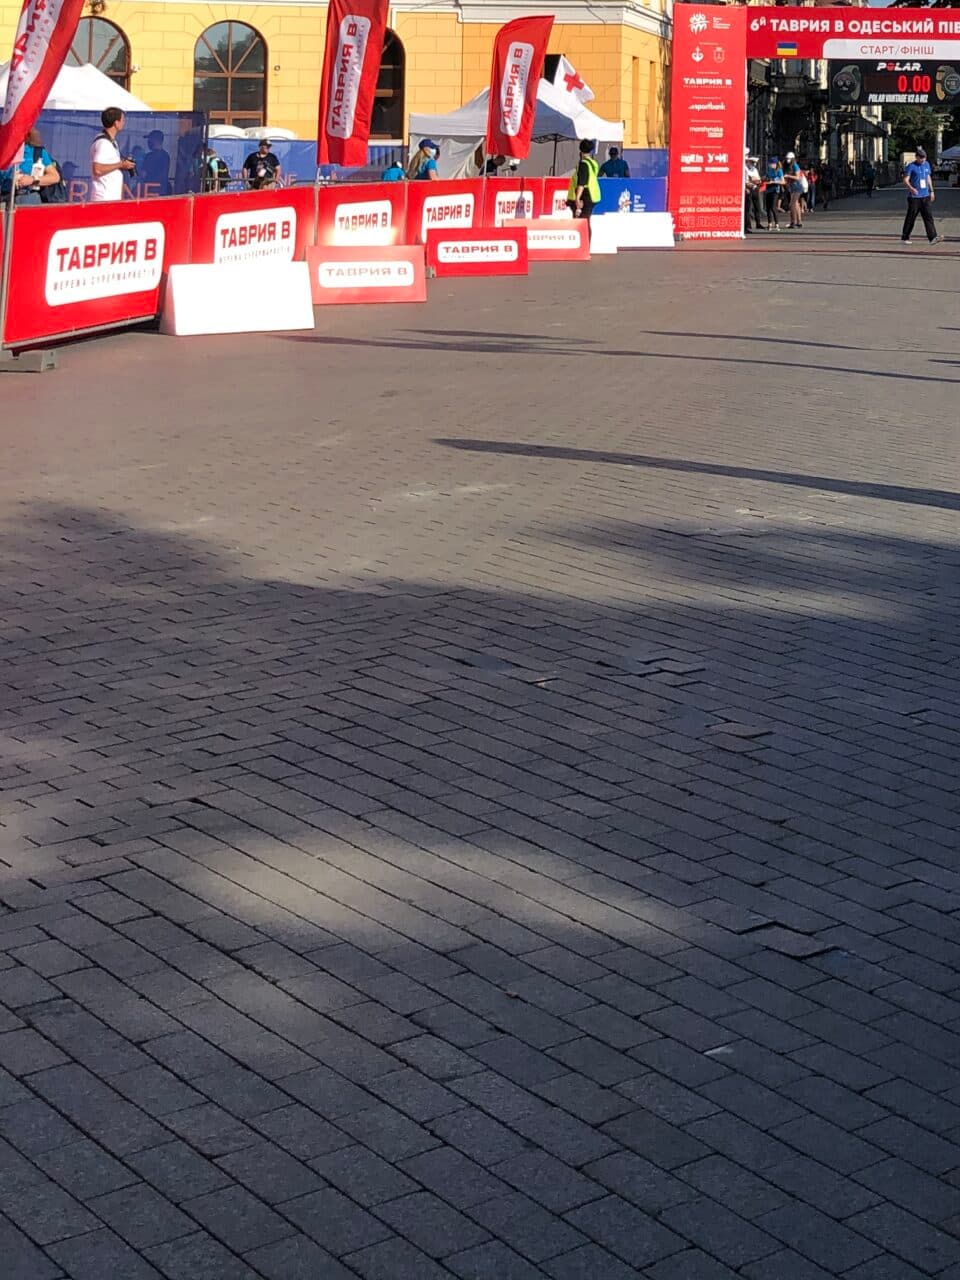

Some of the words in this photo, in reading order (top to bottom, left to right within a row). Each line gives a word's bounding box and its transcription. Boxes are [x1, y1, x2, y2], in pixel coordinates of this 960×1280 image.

[770, 19, 830, 33] ТАВРИЯ
[834, 21, 844, 32] В
[848, 18, 934, 35] ОДЕСЬКИЙ
[513, 48, 523, 59] В
[877, 62, 921, 71] POLAR
[332, 44, 353, 129] ТАВРИЯ
[346, 23, 358, 36] В
[683, 77, 722, 86] ТАВРИЯ
[695, 101, 726, 111] sportbank
[426, 204, 461, 222] ТАВРИЯ
[465, 203, 472, 217] В
[497, 201, 523, 214] ТАВРИЯ
[338, 212, 378, 231] ТАВРИЯ
[382, 211, 388, 228] В
[220, 221, 276, 249] ТАВРИЯ
[281, 220, 291, 239] В
[57, 241, 138, 272] ТАВРИЯ
[145, 238, 158, 261] В
[443, 245, 499, 254] ТАВРИЯ
[503, 245, 513, 253] В
[325, 266, 392, 277] ТАВРИЯ
[397, 267, 408, 276] В
